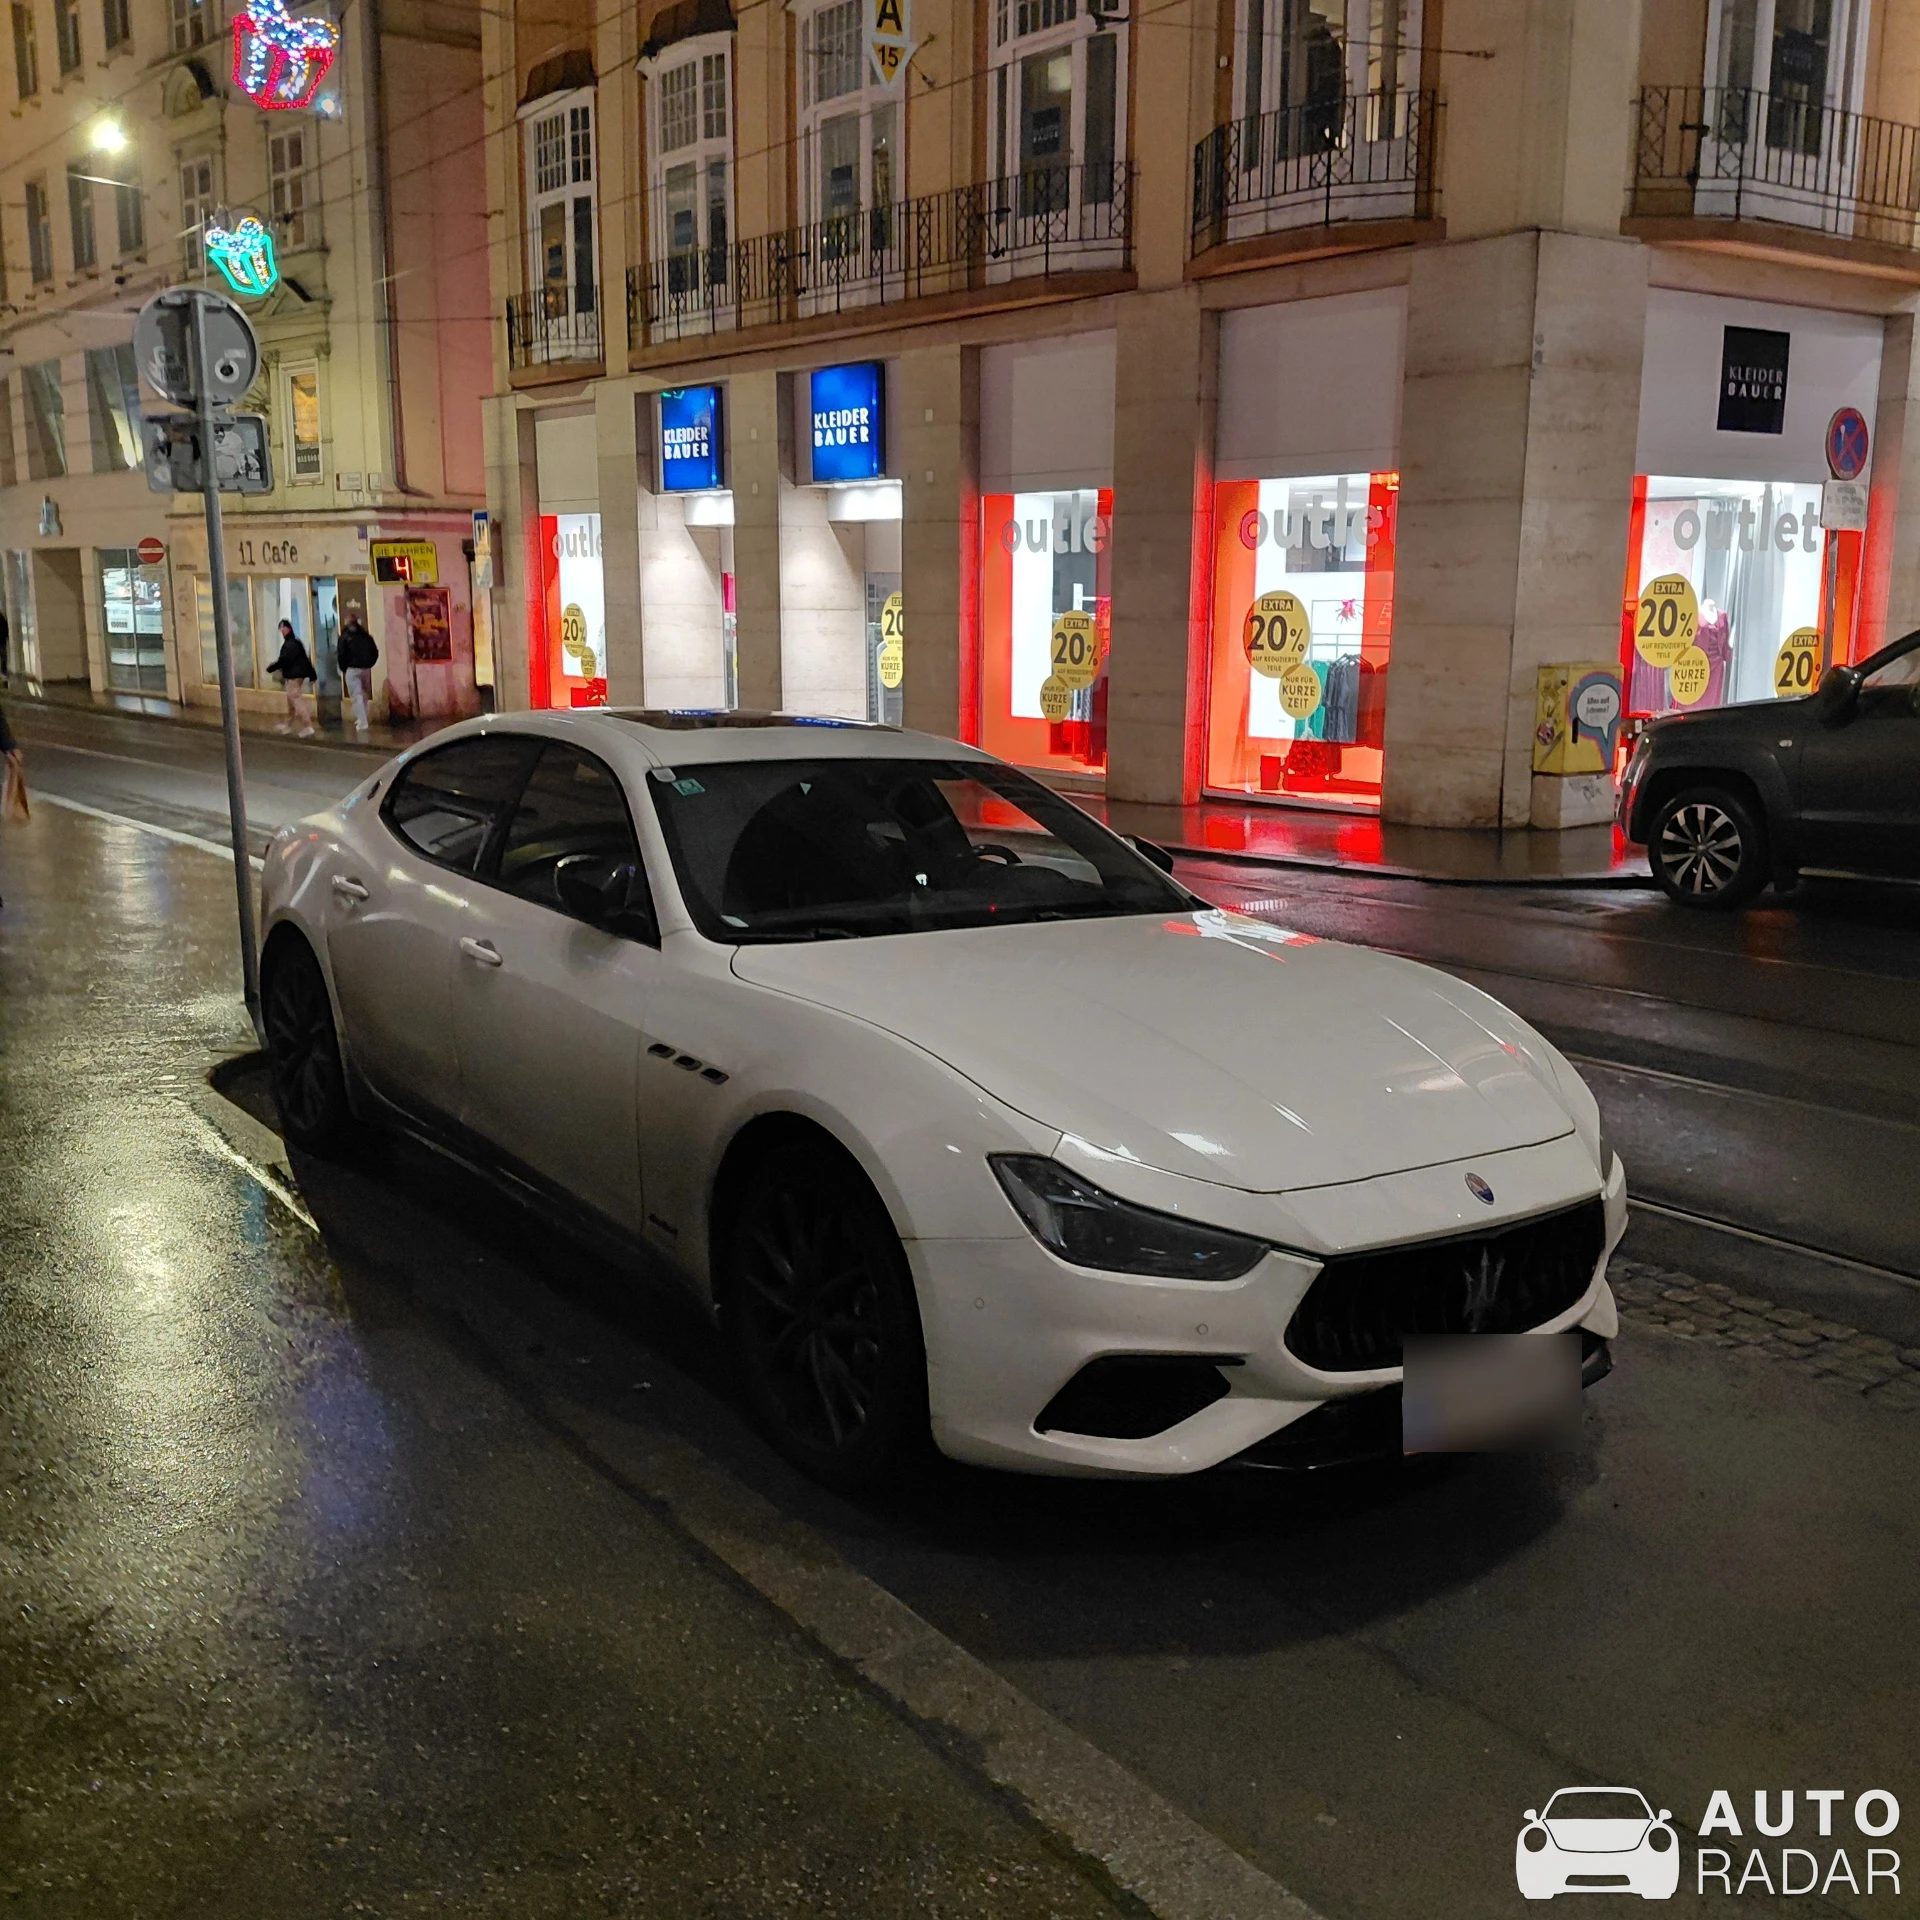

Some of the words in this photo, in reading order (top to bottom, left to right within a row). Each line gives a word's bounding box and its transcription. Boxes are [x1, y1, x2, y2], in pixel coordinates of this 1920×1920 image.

[877, 0, 903, 32] A
[878, 45, 898, 67] 15
[1729, 366, 1783, 384] KLEIDER
[1728, 382, 1782, 400] BAUER
[814, 407, 869, 429] KLEIDER
[664, 427, 708, 444] KLEIDER
[814, 426, 869, 447] BAUER
[664, 443, 709, 459] BAUER
[1673, 483, 1819, 553] outlet
[262, 540, 298, 565] Cafe
[1655, 582, 1684, 594] EXTRA
[1262, 600, 1293, 611] EXTRA
[1065, 619, 1089, 629] EXTRA
[1638, 599, 1693, 637] 20%
[563, 618, 586, 641] 20%
[1248, 615, 1304, 652] 20%
[1054, 632, 1098, 666] 20%
[1793, 635, 1819, 647] EXTRA
[881, 663, 900, 671] KURZE
[1674, 669, 1705, 680] KURZE
[885, 672, 897, 680] ZEIT
[1282, 685, 1316, 697] KURZE
[1678, 682, 1698, 692] ZEIT
[1043, 693, 1068, 704] KURZE
[1287, 698, 1309, 708] ZEIT
[1047, 704, 1063, 714] ZEIT
